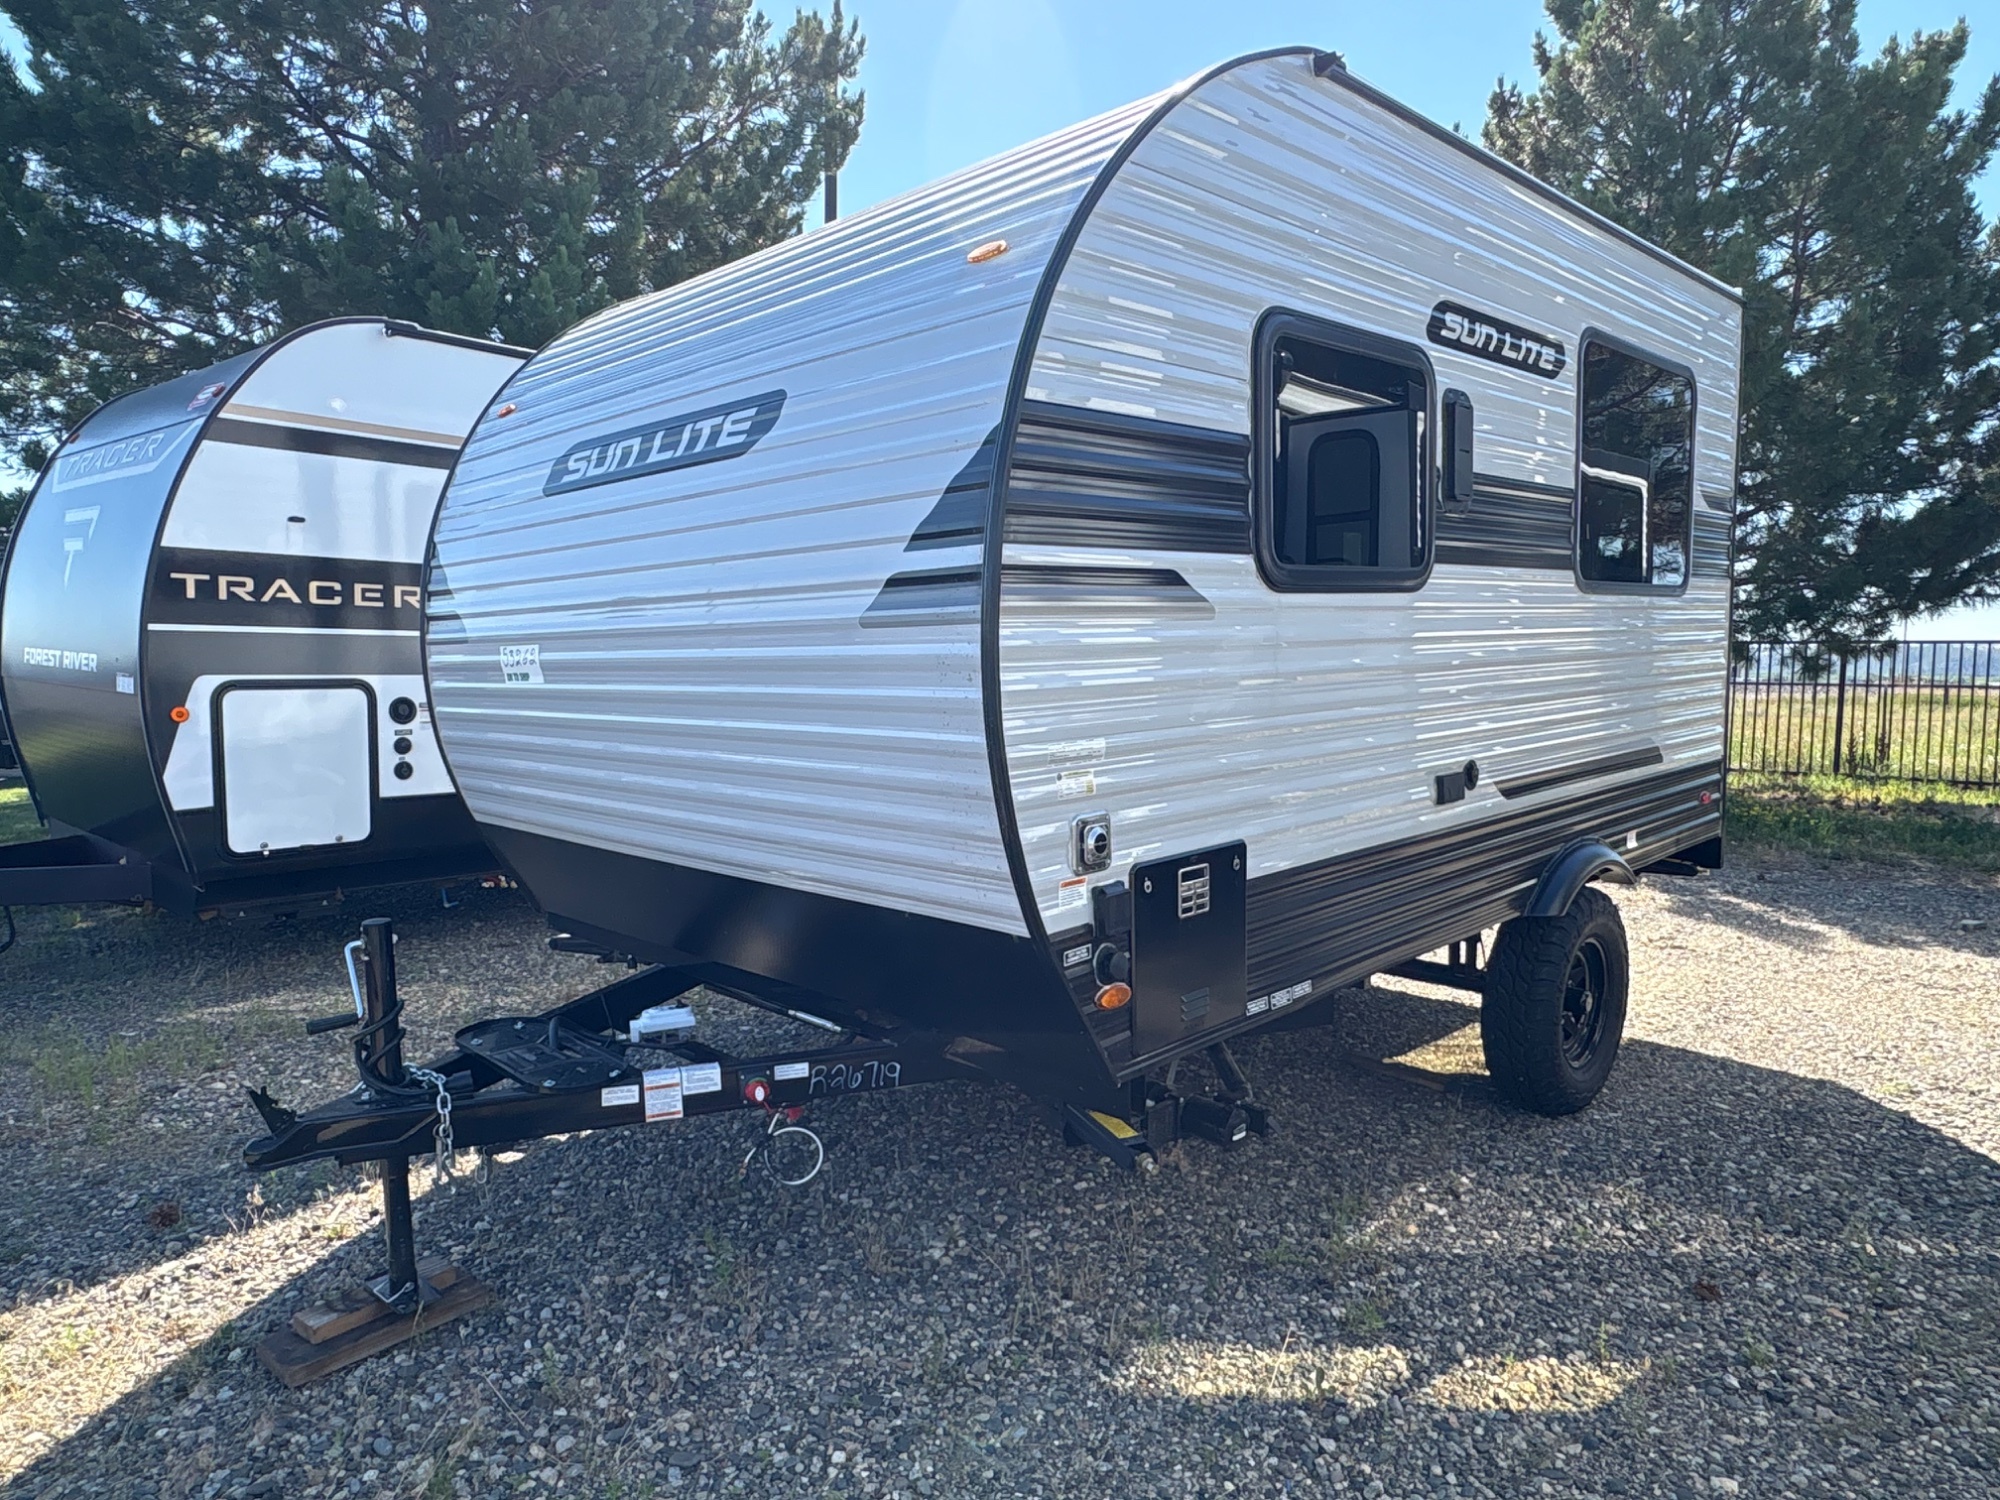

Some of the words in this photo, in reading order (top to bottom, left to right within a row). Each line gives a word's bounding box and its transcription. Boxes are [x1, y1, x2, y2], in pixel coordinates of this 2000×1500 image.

[1440, 312, 1498, 352] SUN
[1501, 332, 1556, 370] LITE
[63, 433, 165, 478] TRACER
[561, 436, 642, 483] SUN
[646, 407, 759, 463] LITE
[170, 572, 420, 609] TRACER
[24, 647, 62, 668] FOREST
[62, 651, 98, 672] RIVER
